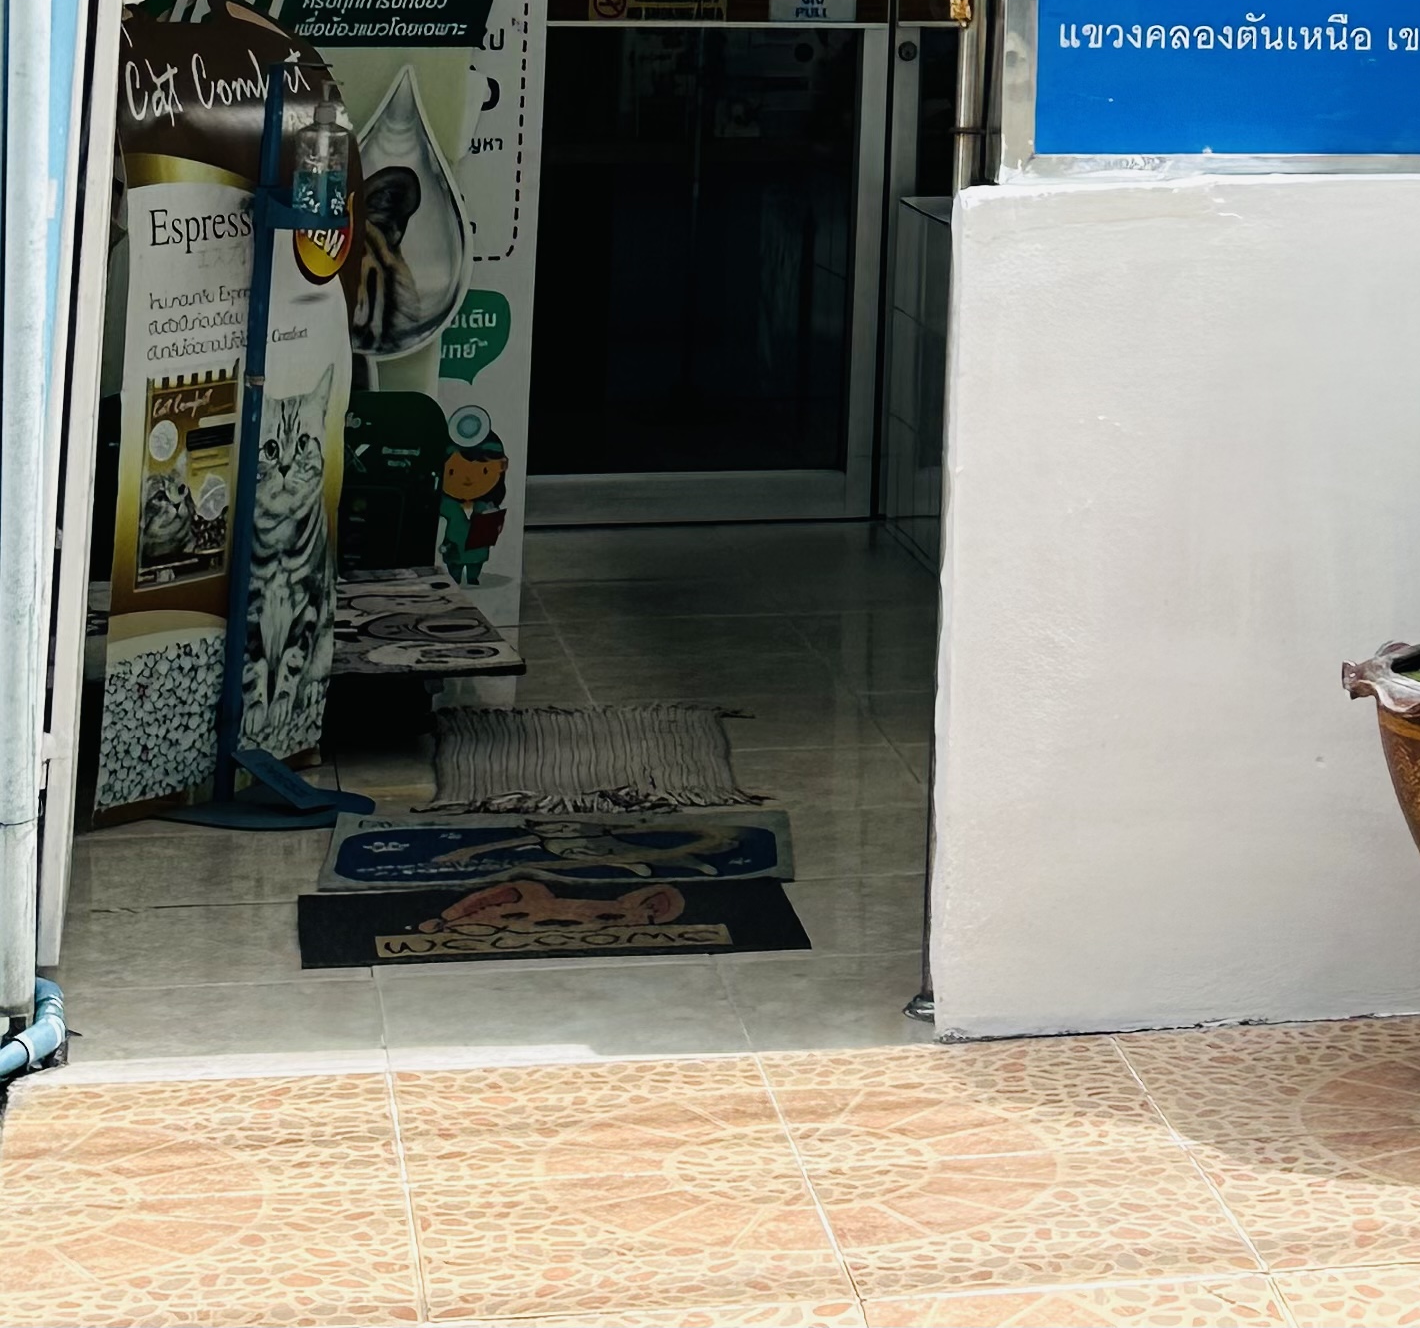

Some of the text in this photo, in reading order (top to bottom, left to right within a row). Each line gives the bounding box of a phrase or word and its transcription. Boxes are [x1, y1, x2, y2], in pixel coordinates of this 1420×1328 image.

[1058, 12, 1373, 52] แขวงคลองตันเหนือ
[125, 58, 184, 129] Cat
[148, 208, 252, 255] Espress
